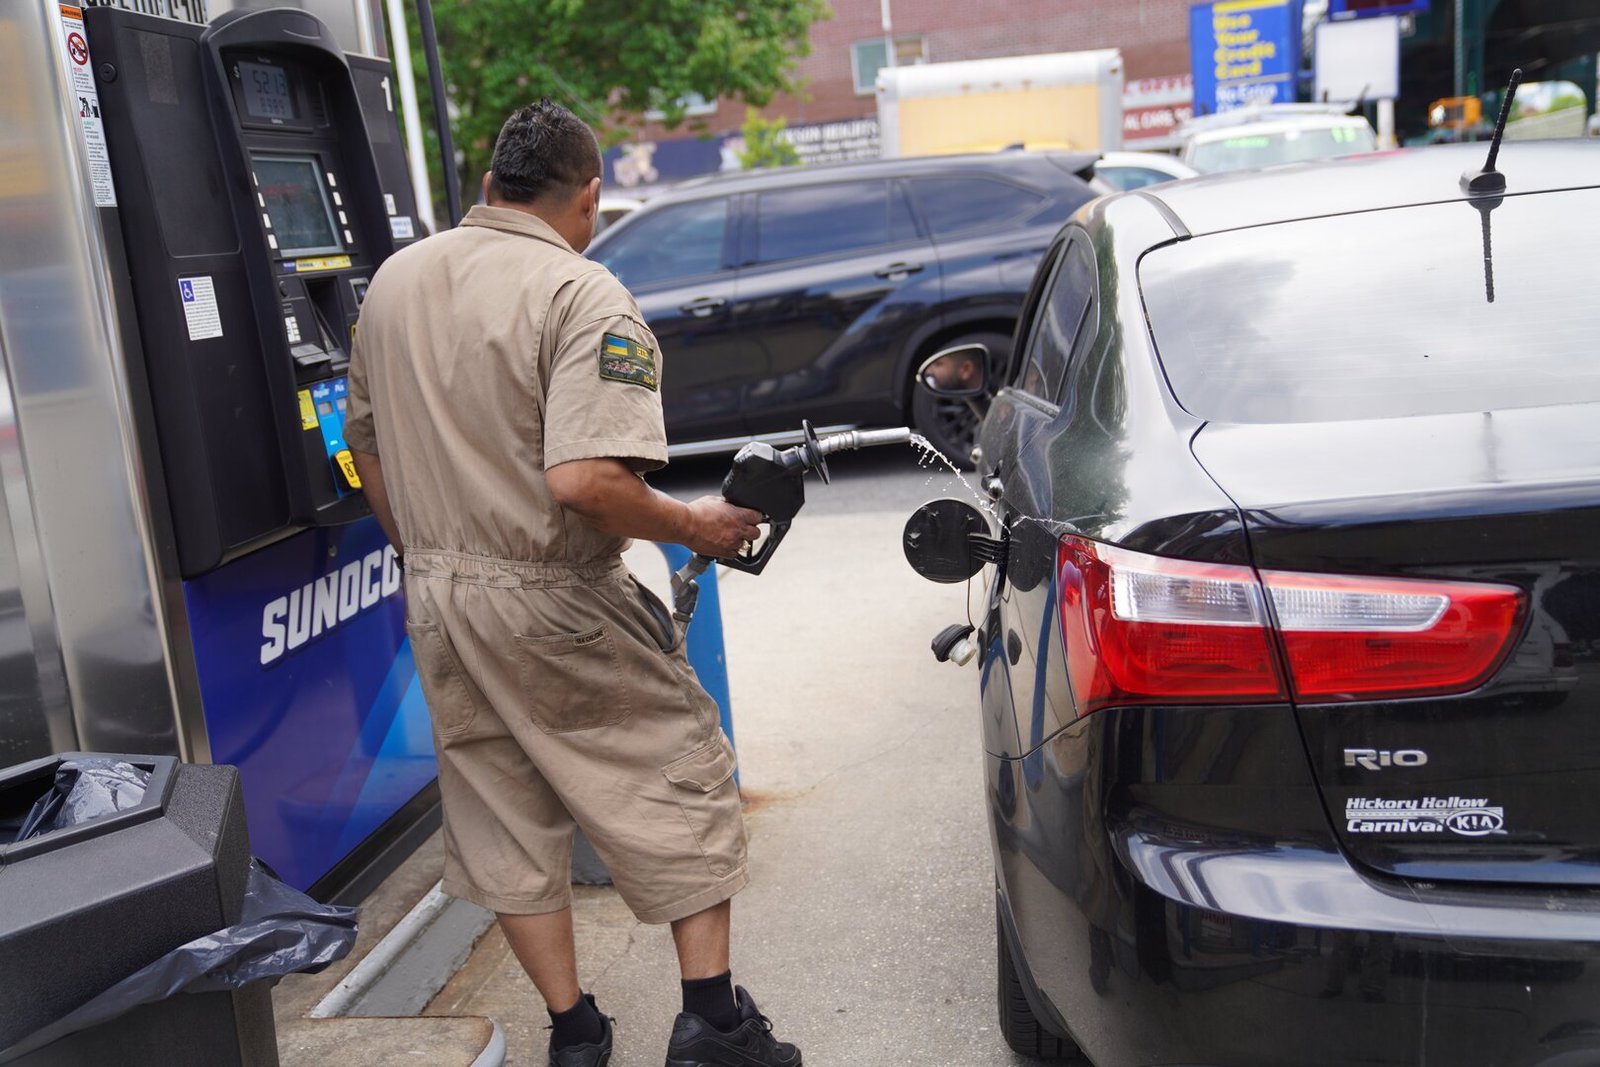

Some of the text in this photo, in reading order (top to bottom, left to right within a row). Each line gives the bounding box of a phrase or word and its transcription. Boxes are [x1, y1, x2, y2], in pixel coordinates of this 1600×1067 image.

[1213, 14, 1252, 29] Use
[1214, 29, 1259, 47] Your
[1214, 41, 1275, 63] Credit
[1215, 60, 1262, 80] Card
[381, 76, 393, 112] 1
[1124, 113, 1141, 131] AL
[260, 543, 401, 666] SUNOCO
[1344, 748, 1428, 770] RIO
[1346, 796, 1488, 810] Hickory Hollow
[1346, 815, 1494, 833] Carnival KIA
